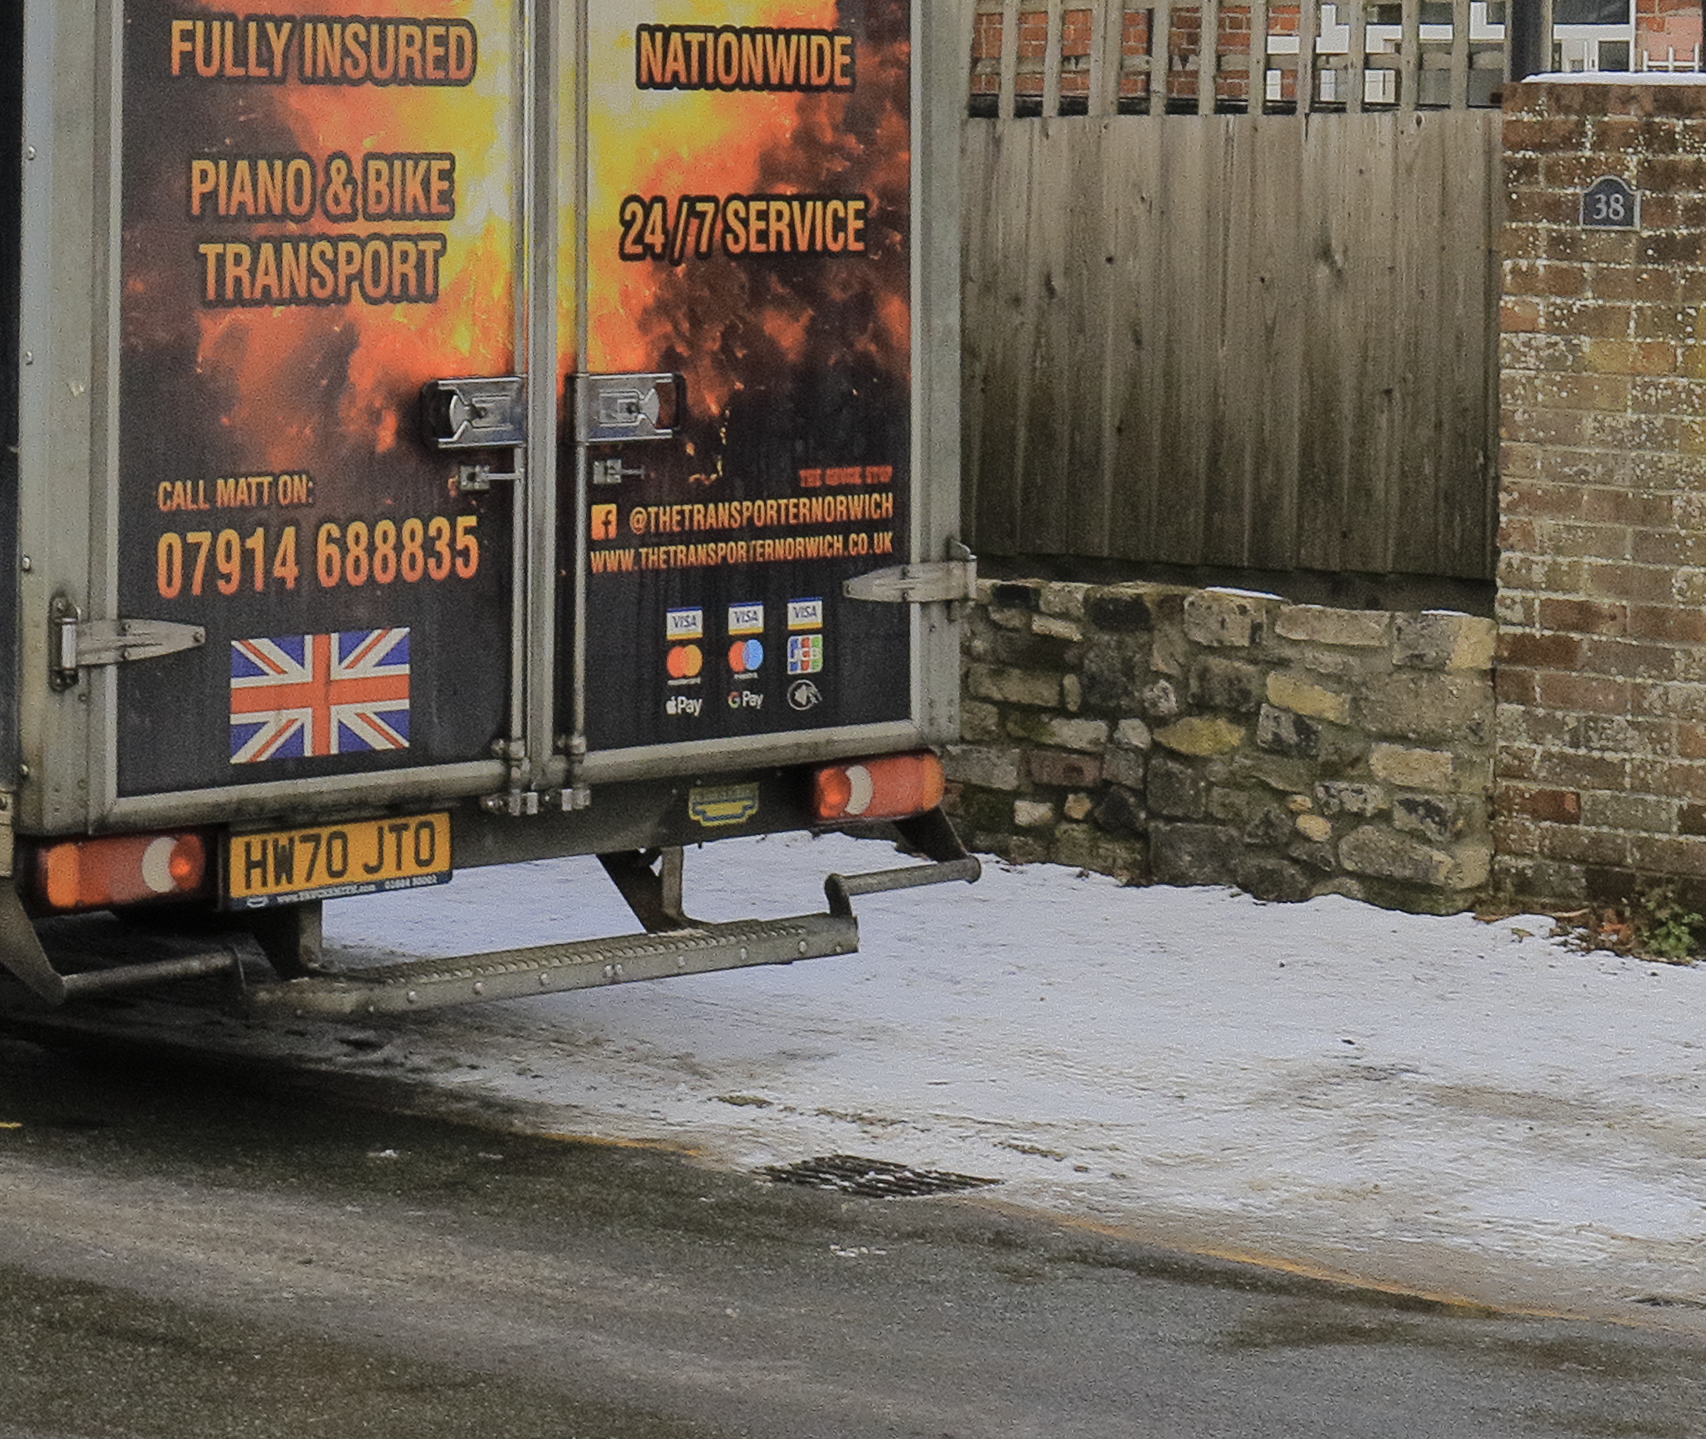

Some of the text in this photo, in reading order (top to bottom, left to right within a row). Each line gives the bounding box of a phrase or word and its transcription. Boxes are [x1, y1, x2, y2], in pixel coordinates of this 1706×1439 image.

[170, 20, 475, 84] FULLY INSURED
[638, 28, 853, 88] NATIONWIDE
[190, 160, 451, 218] PIANO & BIKE
[1592, 193, 1625, 220] 38
[723, 201, 865, 256] SERVICE
[200, 242, 443, 302] TRANSPORT
[157, 475, 313, 513] CALL MATT ON:
[629, 492, 893, 535] @THETRANSPORTERNORWICH
[156, 515, 479, 599] 07914 688835
[590, 531, 893, 574] WWW.THETRANSPORTERNORWICH.CO.UK
[672, 605, 818, 629] VISA VISA VISA
[677, 696, 703, 716] Pay
[742, 690, 764, 709] Pay
[245, 820, 436, 890] HW70 JTO
